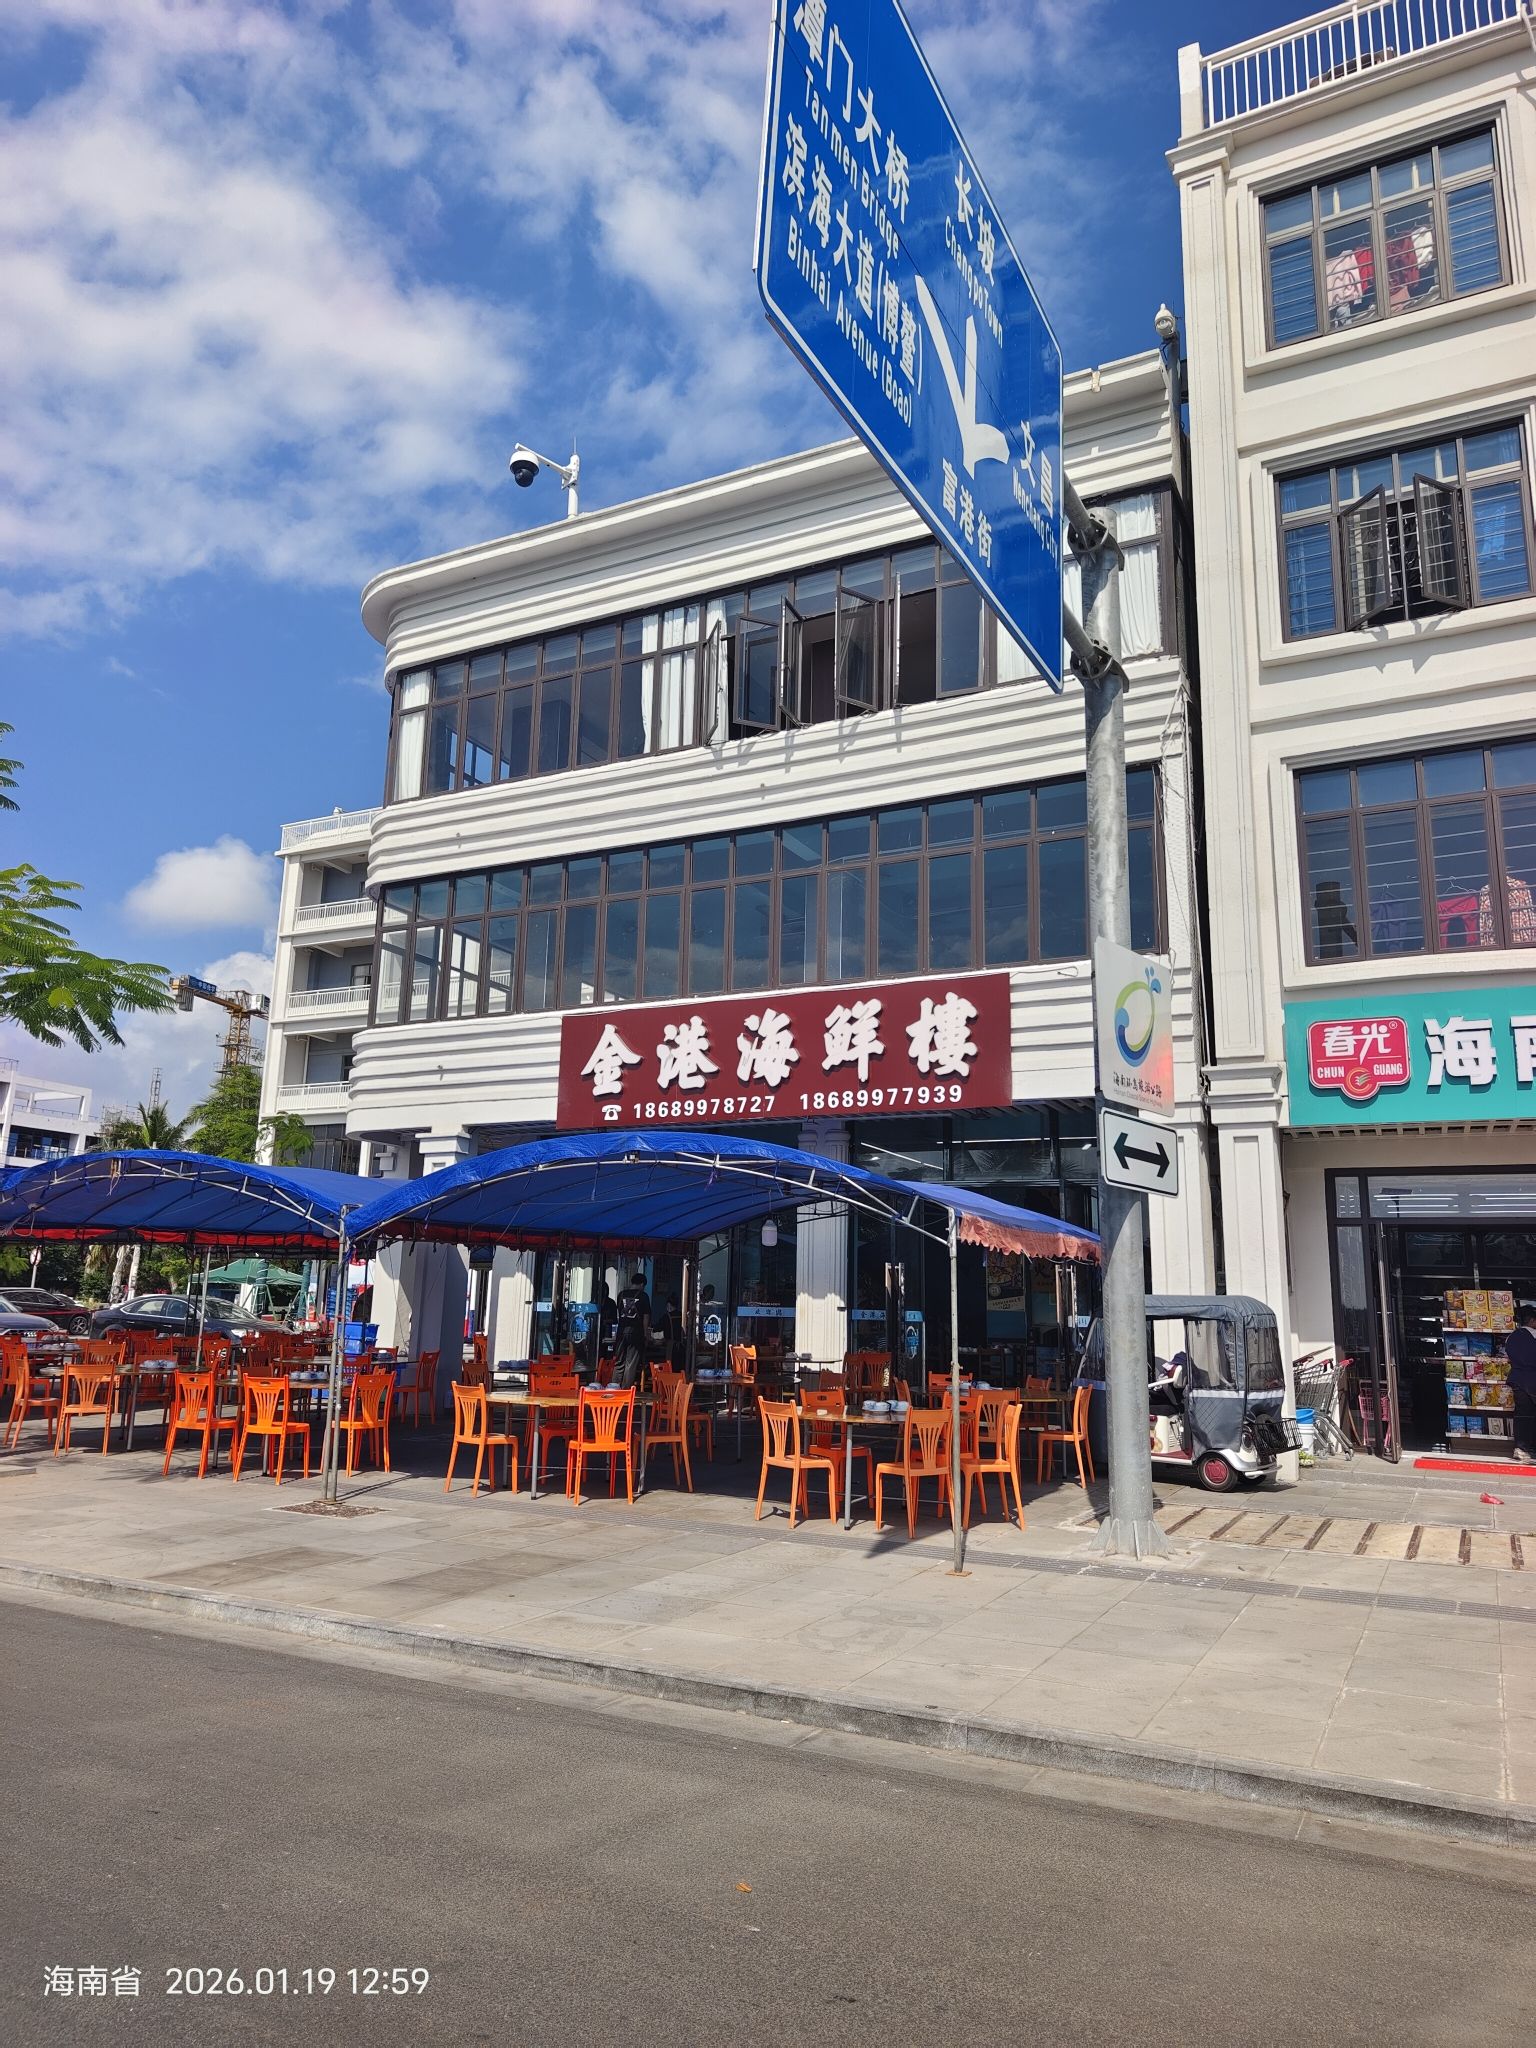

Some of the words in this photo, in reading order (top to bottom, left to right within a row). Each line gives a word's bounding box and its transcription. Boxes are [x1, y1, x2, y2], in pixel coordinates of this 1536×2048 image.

[806, 65, 857, 190] Tanmen
[861, 167, 899, 259] Bridge
[954, 159, 996, 287] 长坡
[787, 214, 831, 312] Binhai
[835, 290, 879, 380] Avenue
[881, 355, 913, 428] (Boao)
[942, 457, 992, 568] 富港街
[1020, 420, 1054, 519] 文昌
[1045, 522, 1058, 570] City
[1317, 1066, 1345, 1079] CHUN
[1373, 1062, 1403, 1076] GUANG
[1322, 1022, 1391, 1065] 春光
[633, 1095, 775, 1119] 18689978727
[800, 1084, 962, 1110] 18689977939
